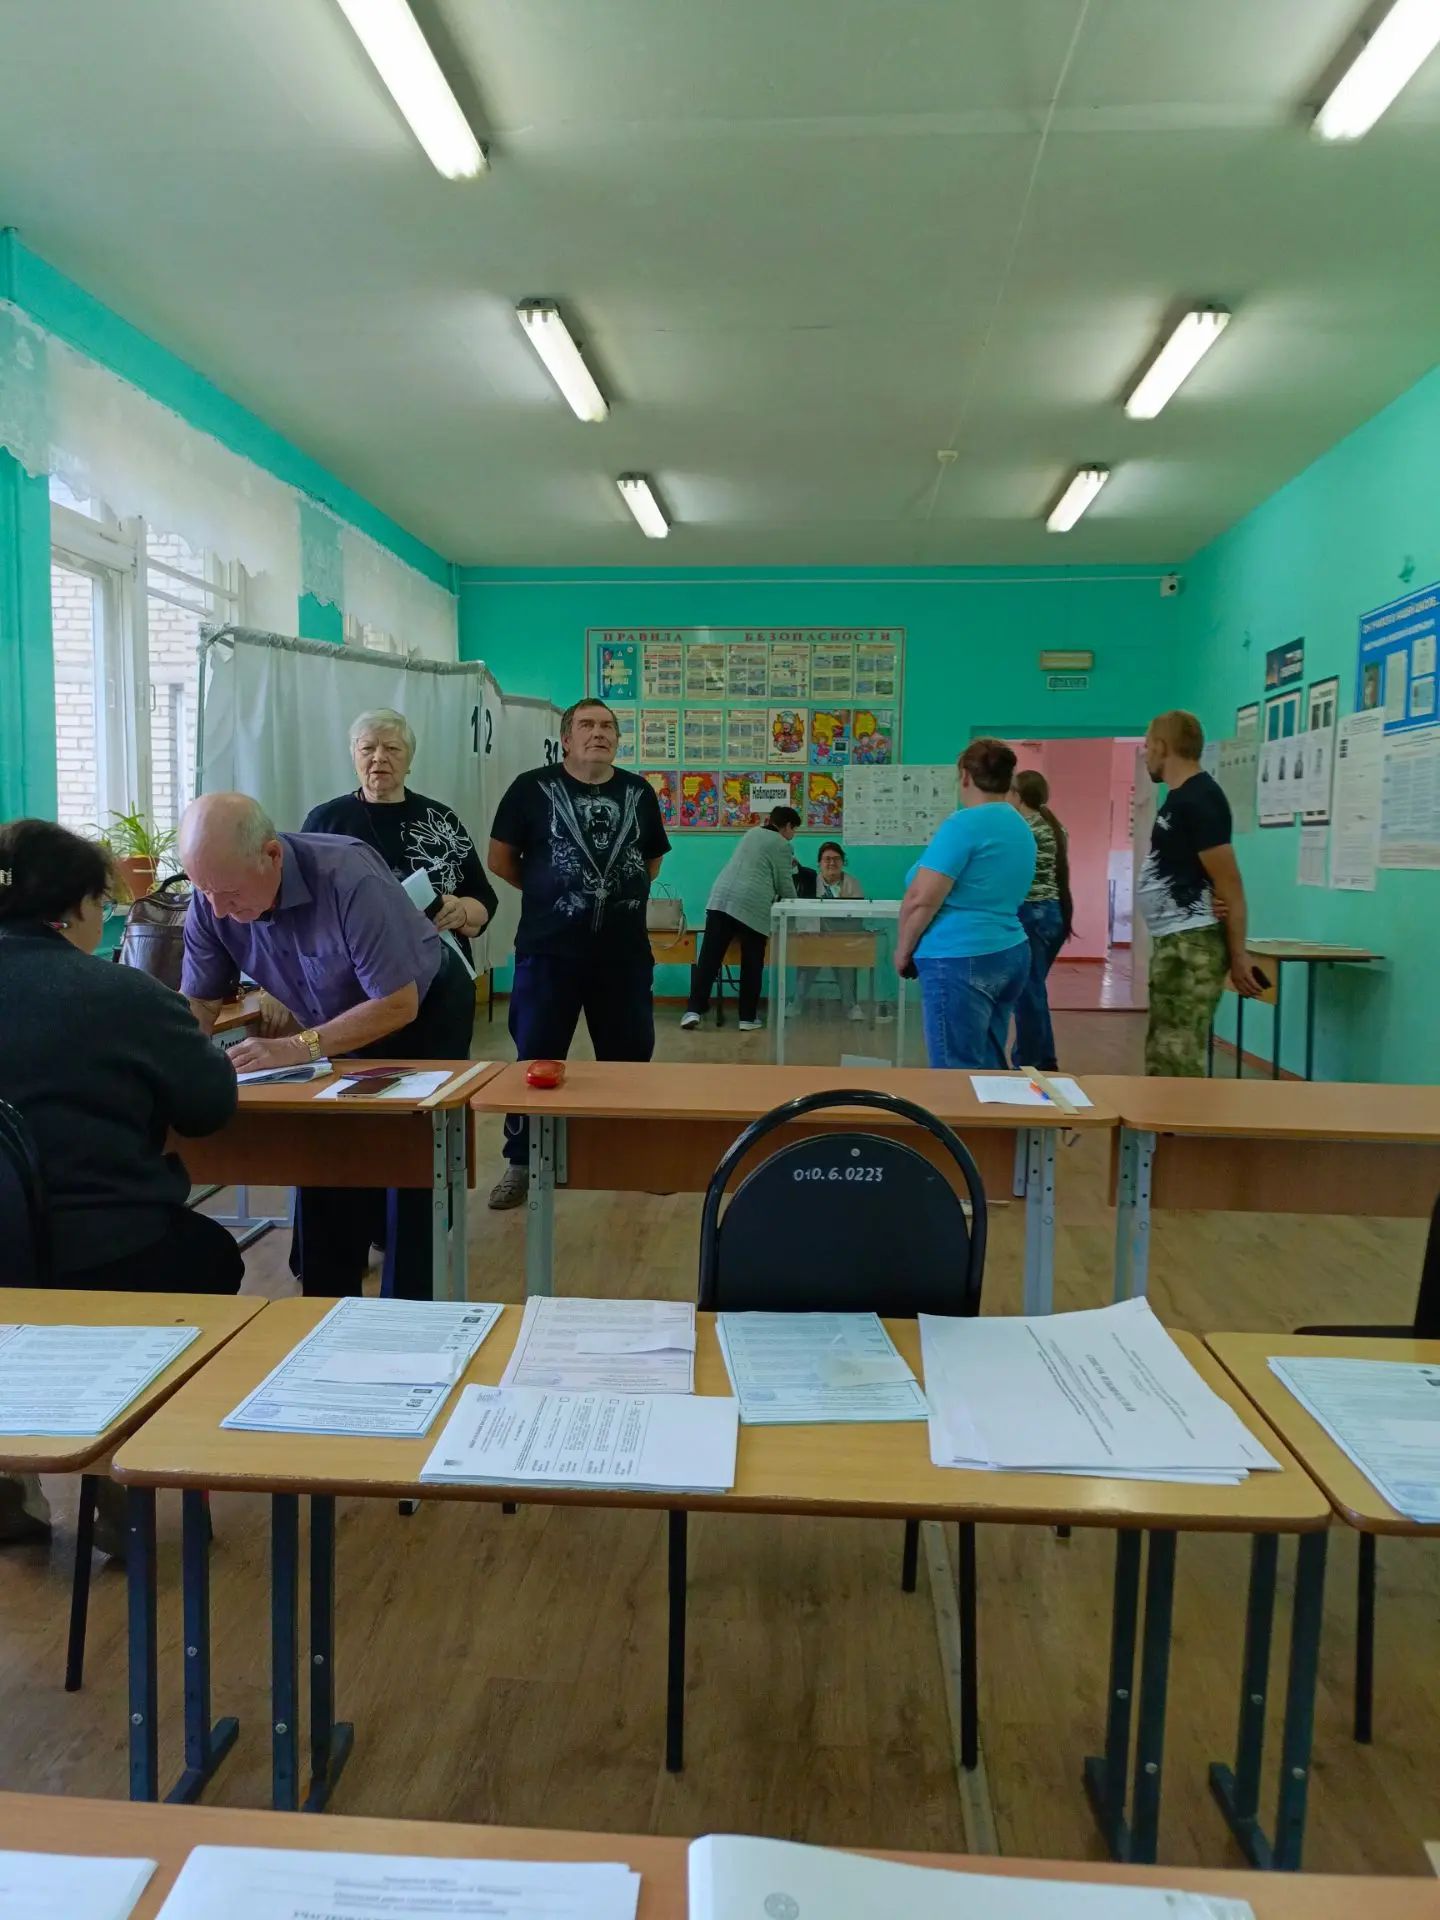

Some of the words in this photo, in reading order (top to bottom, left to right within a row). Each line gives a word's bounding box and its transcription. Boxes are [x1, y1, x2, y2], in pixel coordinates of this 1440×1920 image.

[603, 632, 682, 641] ПРАВИЛА
[745, 632, 891, 641] БЕЗОПАСНОСТИ
[793, 1167, 884, 1182] 010.6.0223
